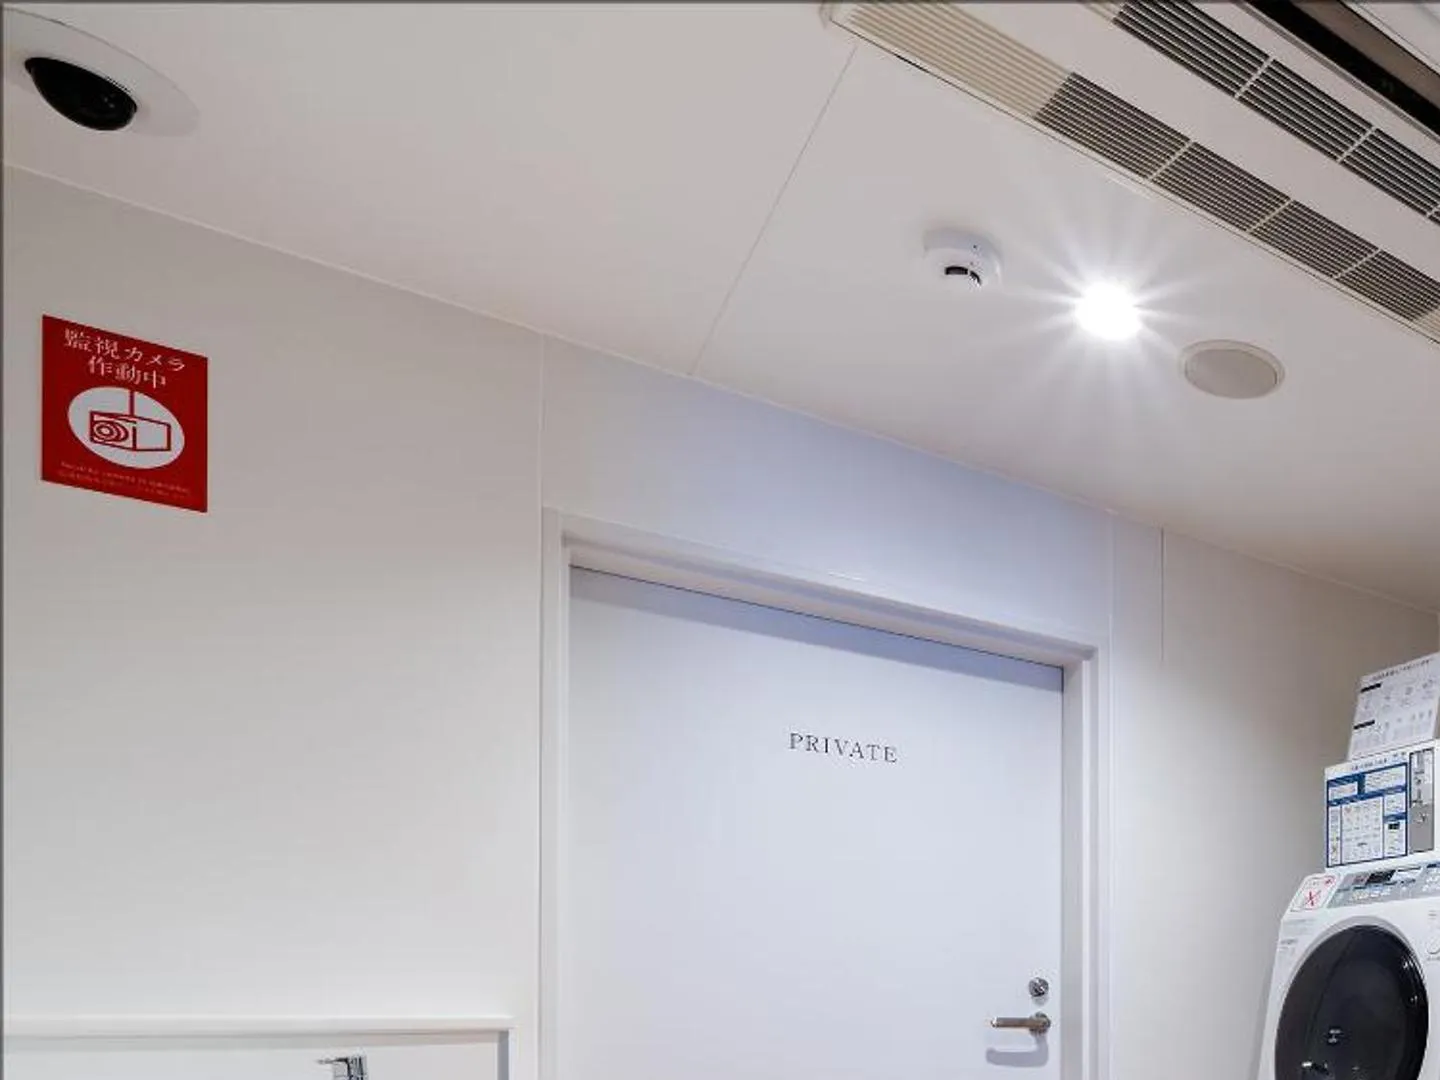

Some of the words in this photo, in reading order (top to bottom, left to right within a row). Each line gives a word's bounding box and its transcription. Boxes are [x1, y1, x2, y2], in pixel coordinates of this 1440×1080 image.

[64, 327, 186, 372] 監視カメラ
[87, 355, 167, 388] 作動中
[789, 732, 898, 763] PRIVATE
